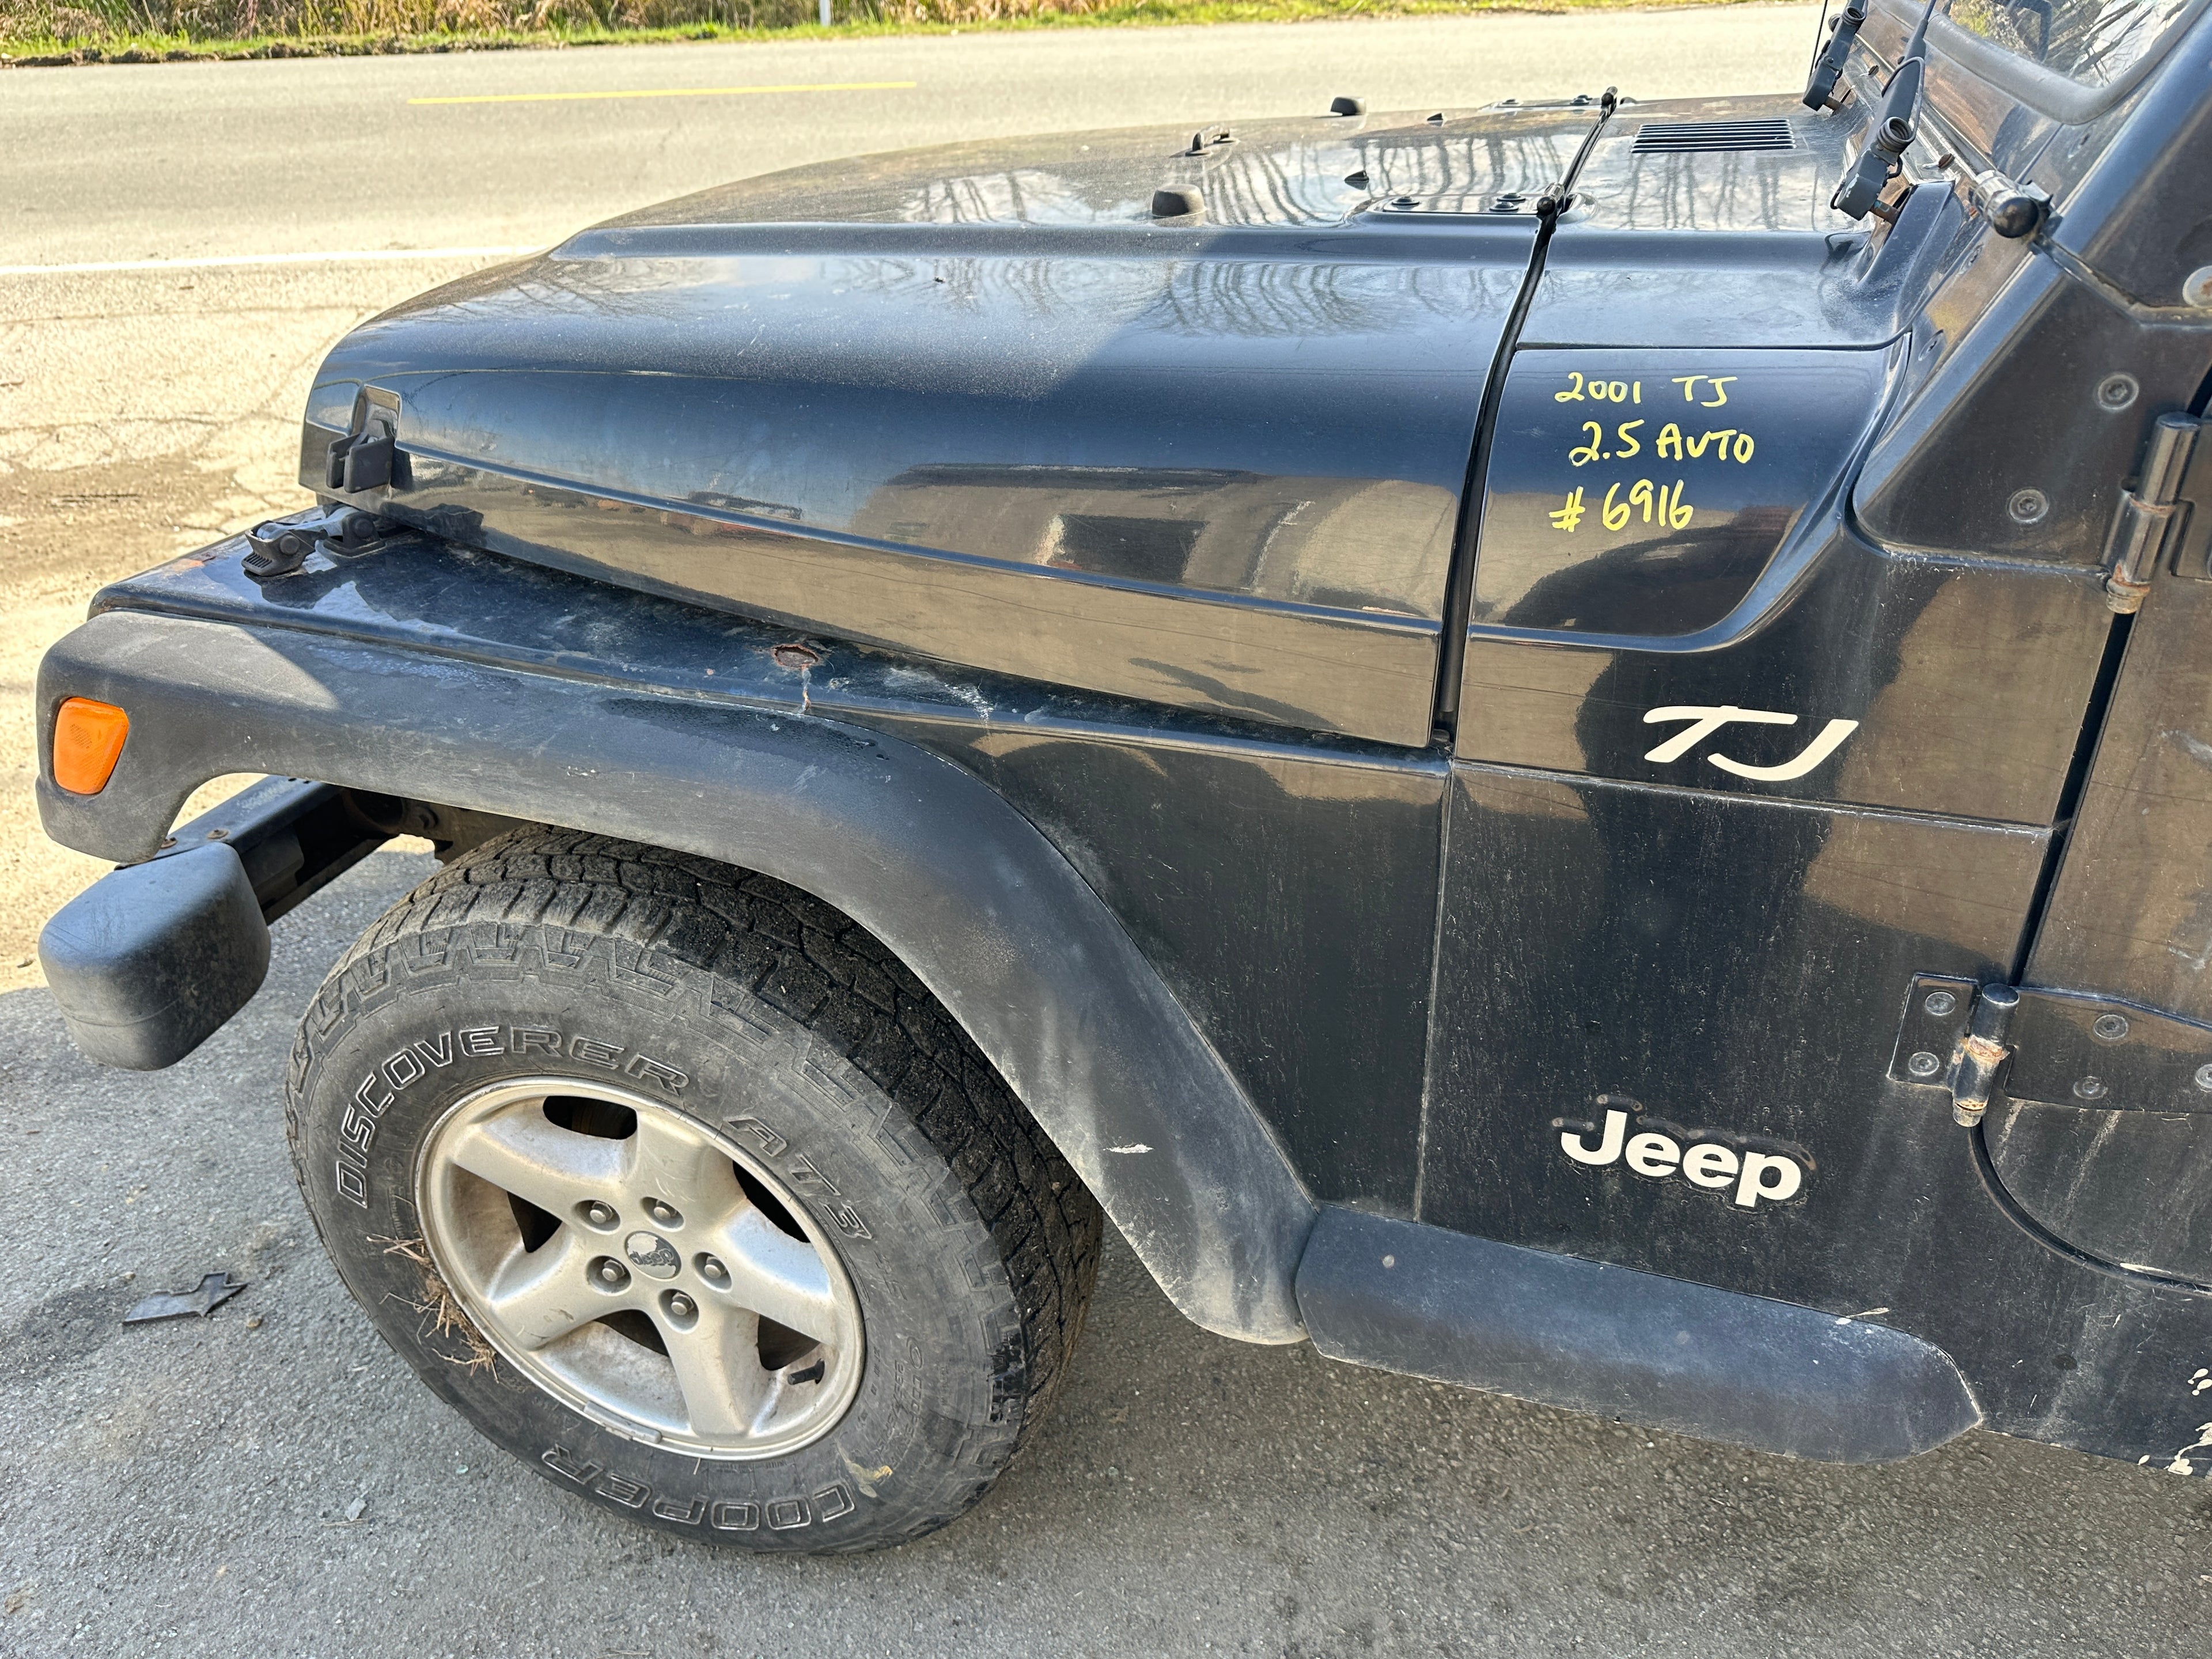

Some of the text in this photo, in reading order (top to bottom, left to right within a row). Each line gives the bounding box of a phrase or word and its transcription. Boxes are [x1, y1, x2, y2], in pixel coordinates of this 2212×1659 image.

[1555, 372, 1738, 407] 2001 TJ
[1569, 419, 1755, 466] 2.5 AUTO
[1643, 705, 1859, 781] TJ
[336, 1025, 690, 1209] DISCOVERER
[1560, 1109, 1801, 1207] Jeep
[541, 1443, 855, 1531] COOPER
